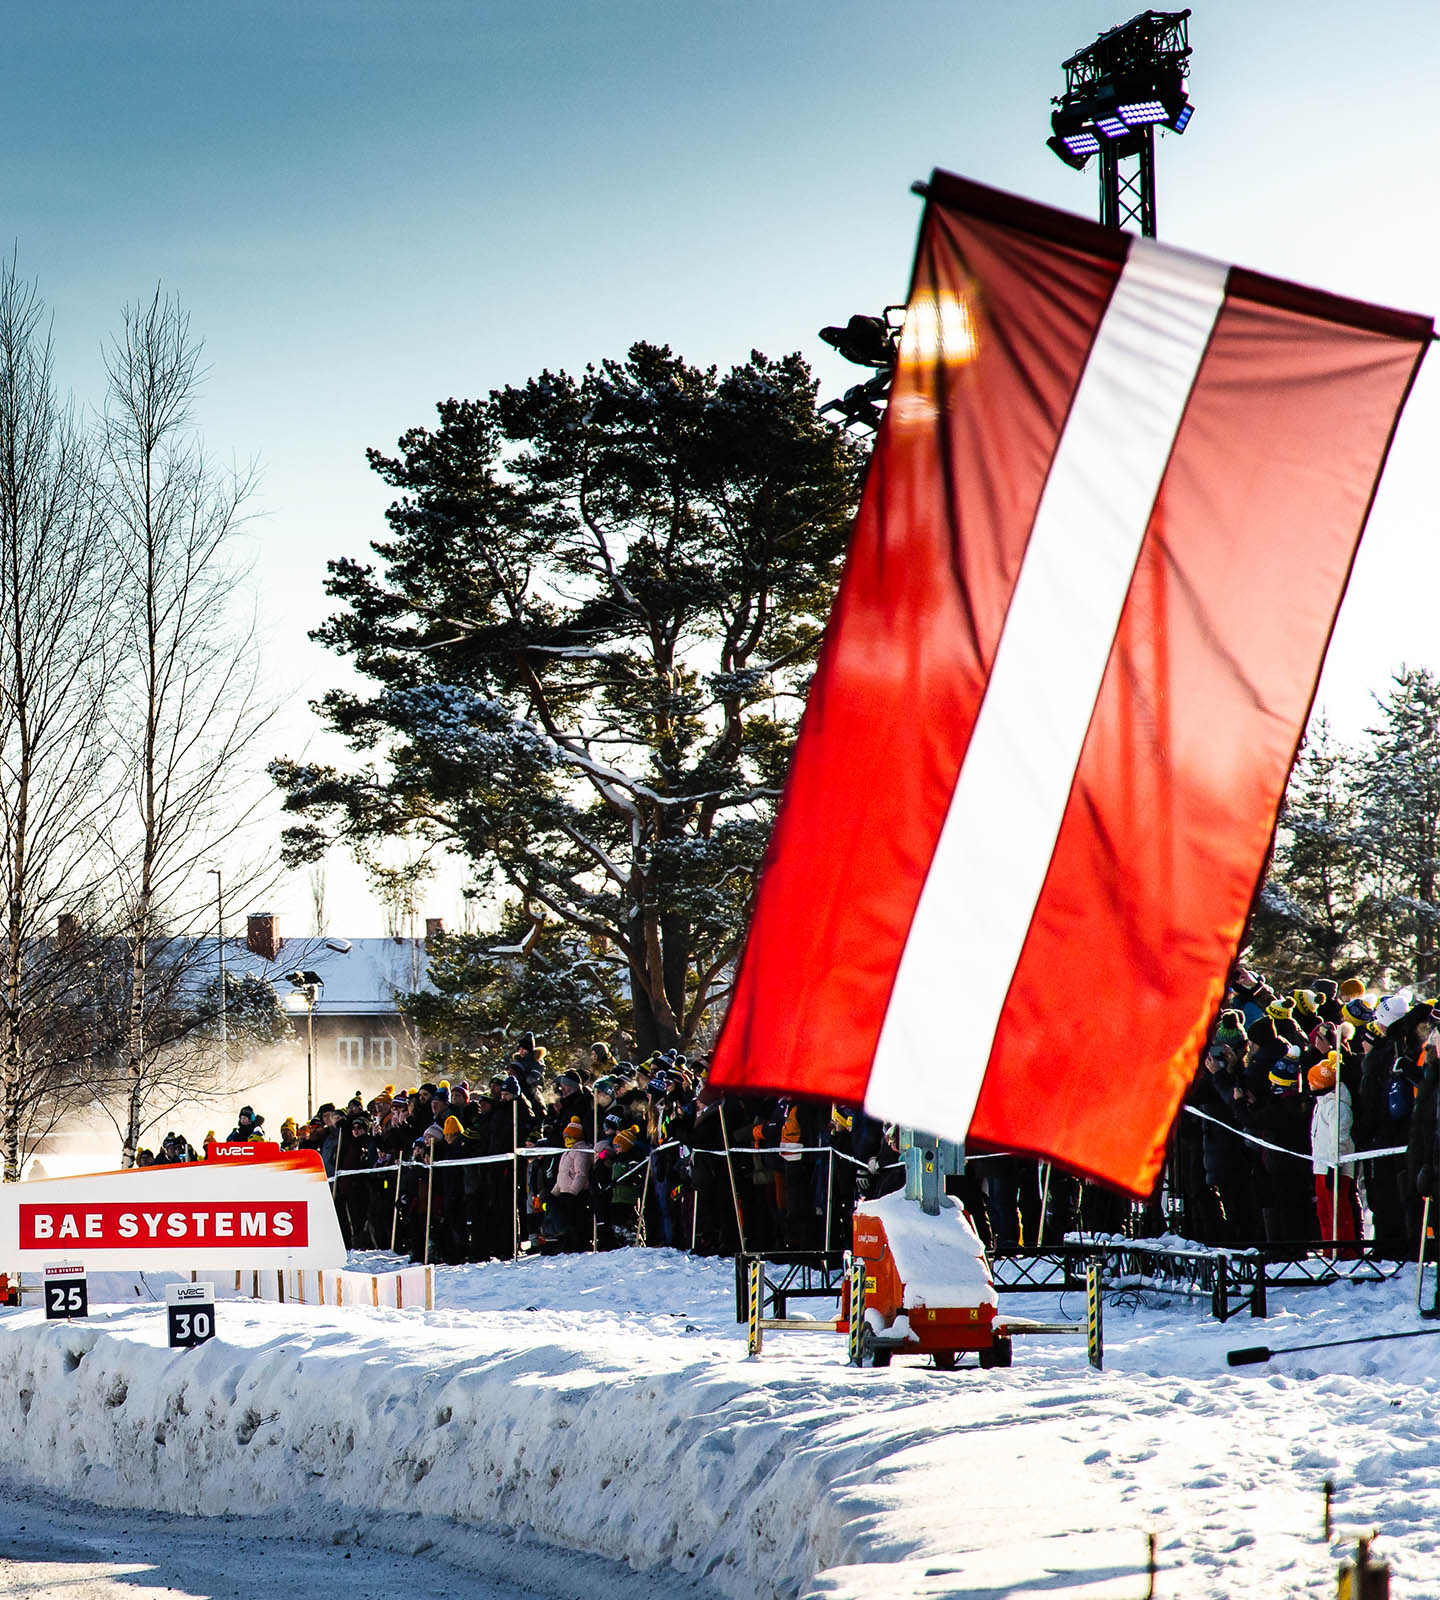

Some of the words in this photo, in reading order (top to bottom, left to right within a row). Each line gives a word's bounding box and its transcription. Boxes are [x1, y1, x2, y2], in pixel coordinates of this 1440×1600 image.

[216, 1146, 255, 1156] WRC
[34, 1213, 103, 1239] BAE
[118, 1212, 294, 1239] SYSTEMS
[51, 1287, 83, 1312] 25
[175, 1313, 210, 1339] 30
